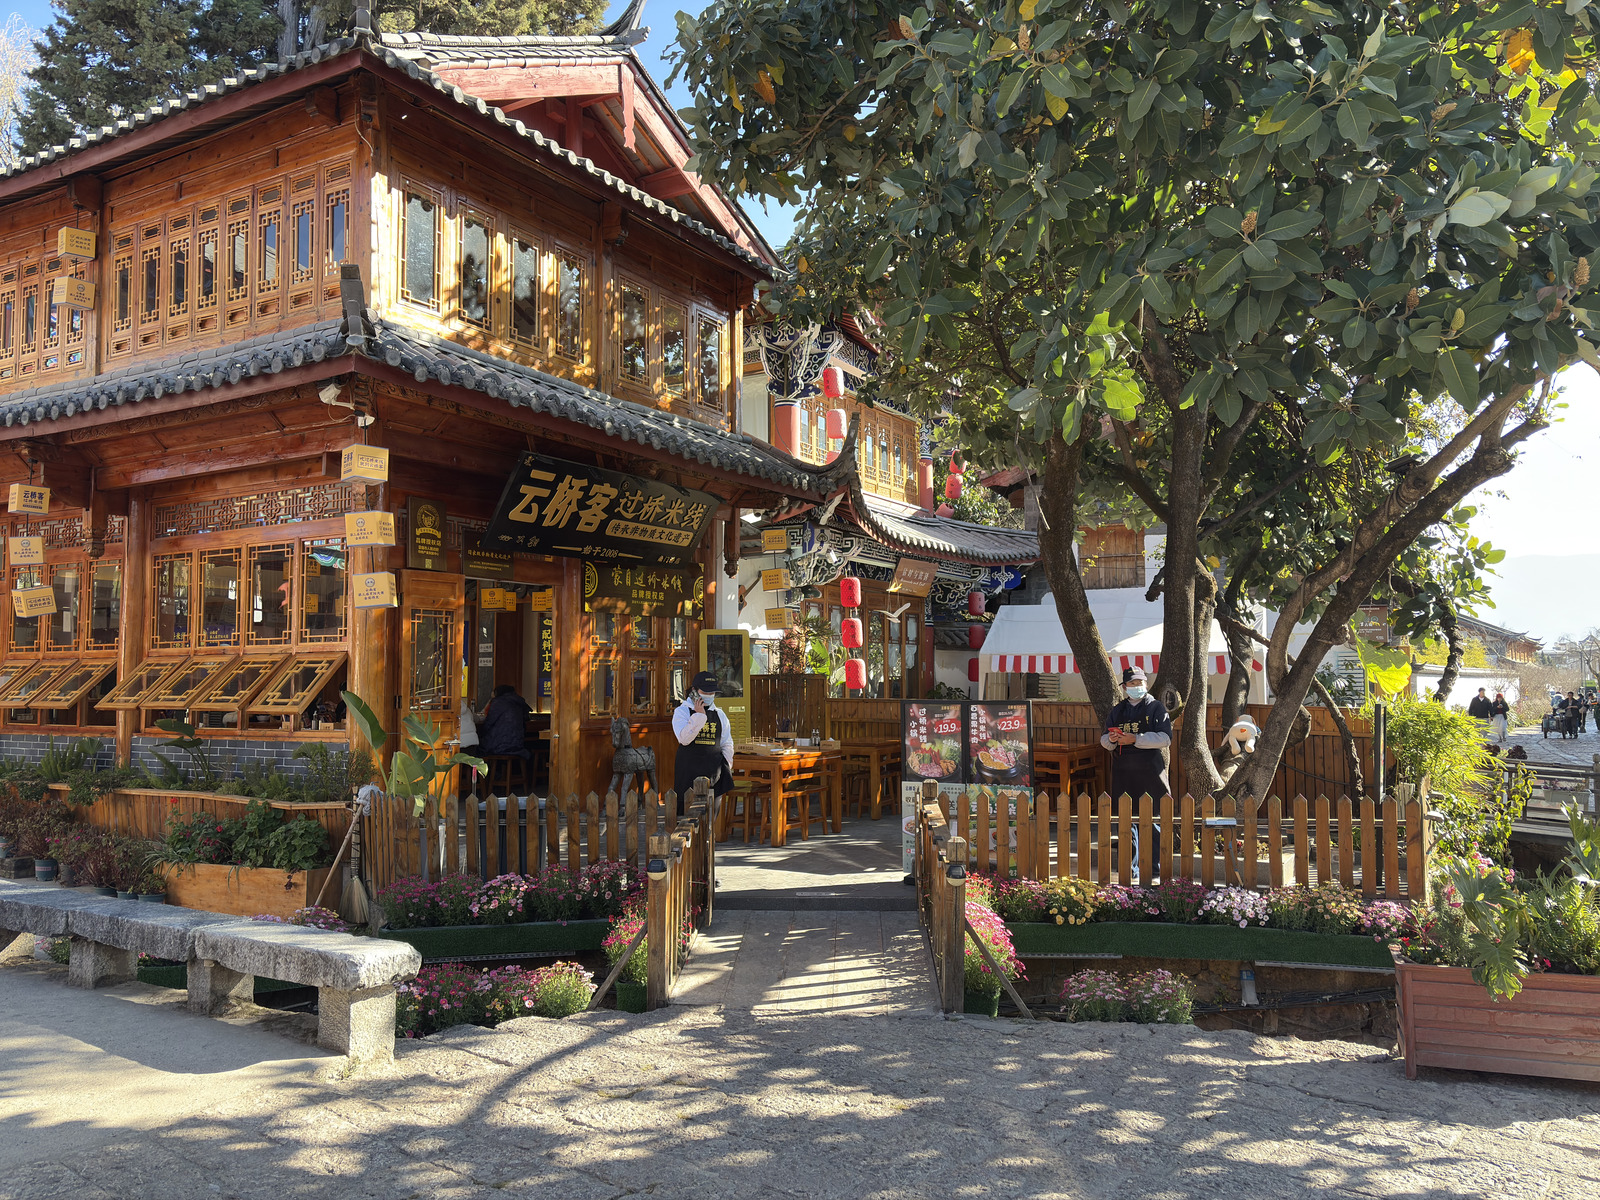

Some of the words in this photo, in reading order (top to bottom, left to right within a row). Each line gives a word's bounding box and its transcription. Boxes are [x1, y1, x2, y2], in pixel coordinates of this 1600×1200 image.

[23, 490, 44, 500] 云桥客
[508, 469, 619, 533] 云桥客
[614, 490, 707, 530] 过桥米线
[611, 522, 690, 544] 传承非物质文化遗产
[581, 545, 619, 559] 始于2008
[632, 589, 664, 601] 品牌授权店
[542, 629, 552, 672] 配料十足
